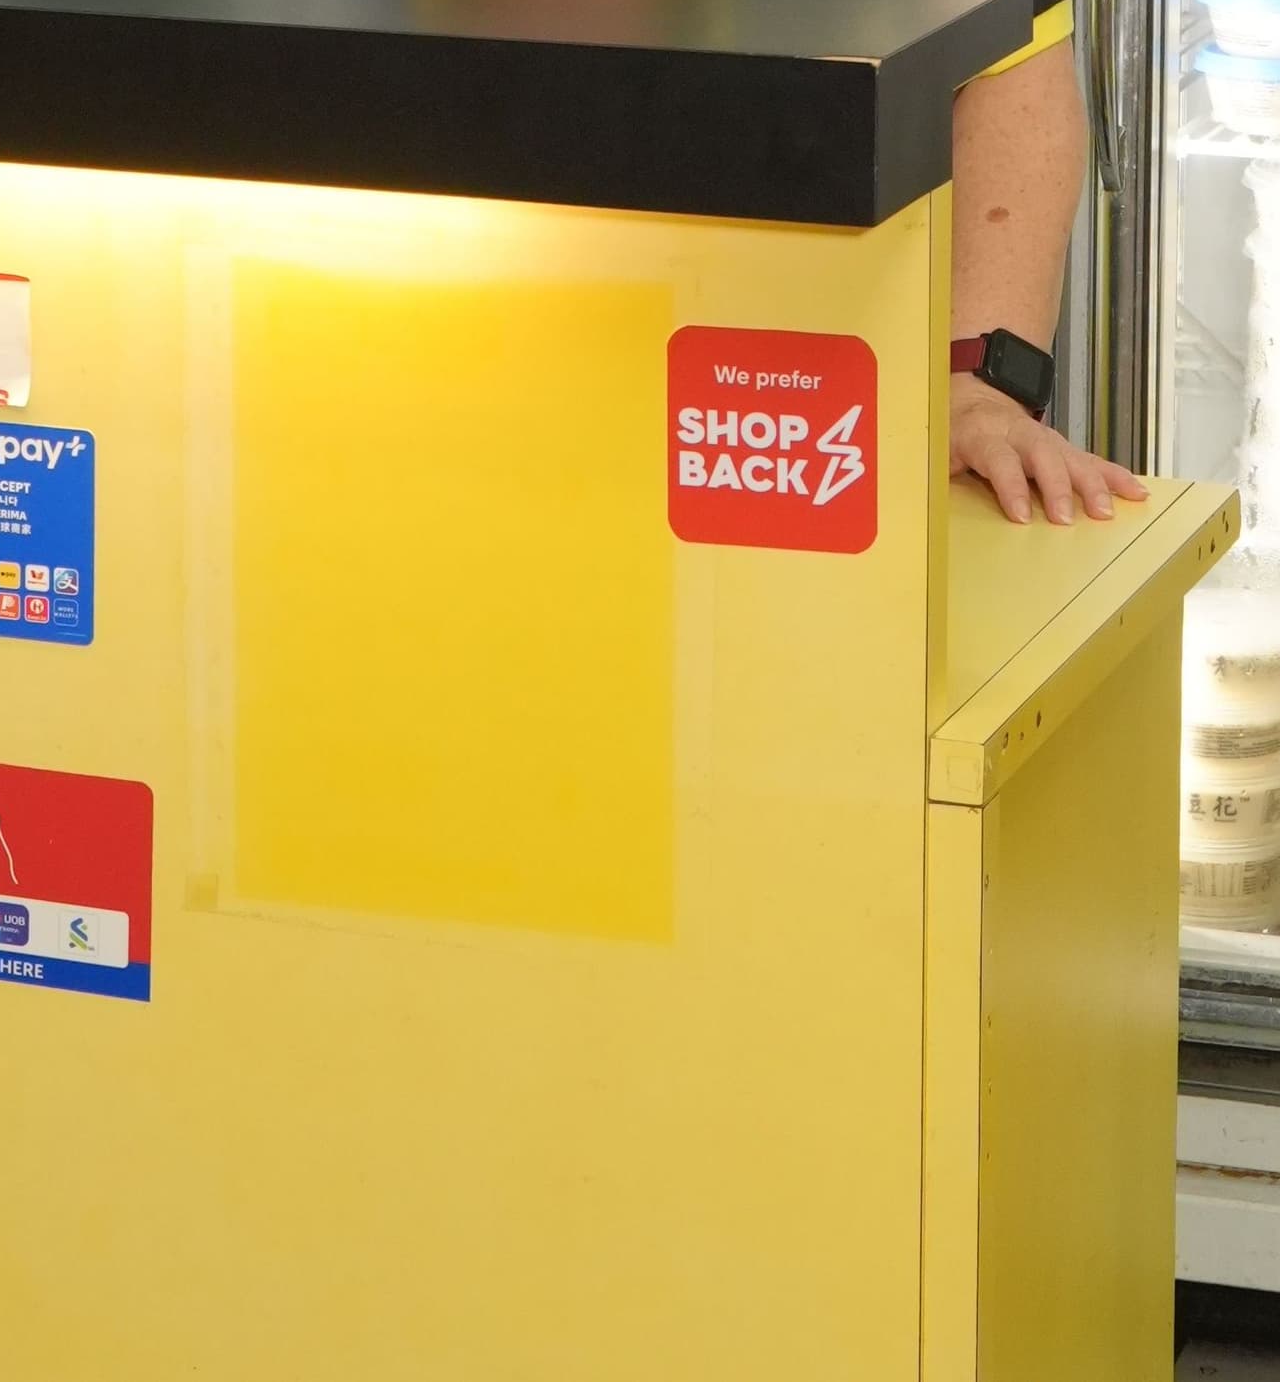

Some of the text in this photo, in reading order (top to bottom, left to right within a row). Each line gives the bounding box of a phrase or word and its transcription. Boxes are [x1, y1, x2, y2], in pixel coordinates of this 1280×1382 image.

[714, 364, 822, 390] We prefer
[677, 407, 809, 451] SHOP
[678, 450, 809, 495] BACK
[4, 914, 26, 926] UOB
[0, 960, 44, 979] HERE
